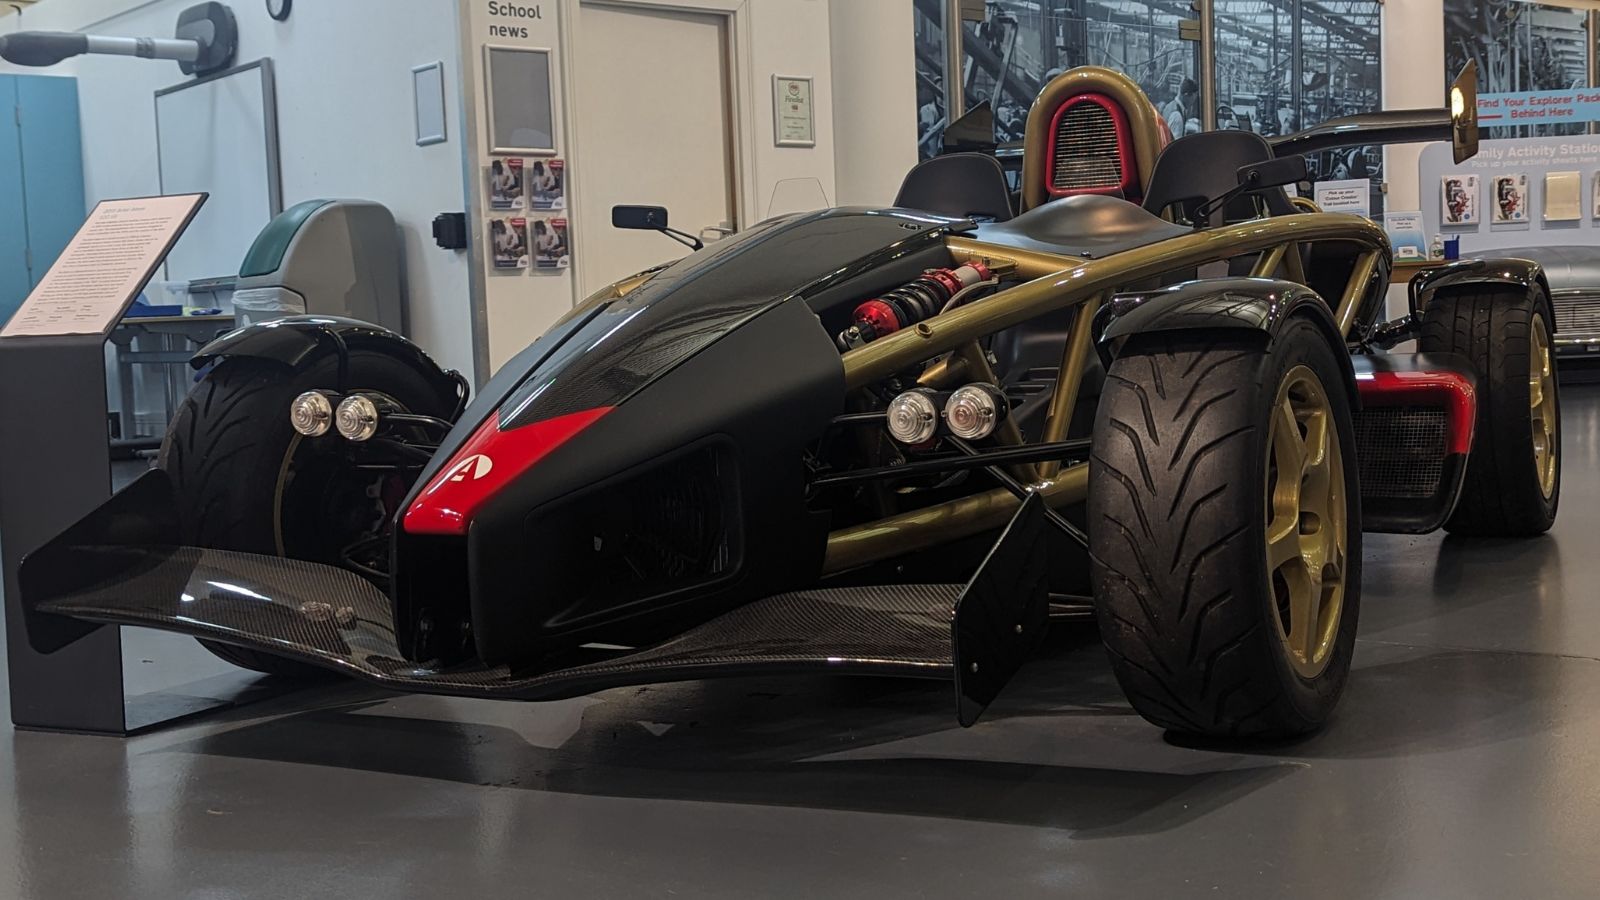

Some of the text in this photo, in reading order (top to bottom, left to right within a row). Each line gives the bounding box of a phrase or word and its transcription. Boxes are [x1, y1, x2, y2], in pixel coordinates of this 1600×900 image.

[488, 0, 542, 20] School
[489, 24, 528, 38] news
[1477, 98, 1499, 108] Find
[1503, 97, 1524, 107] Your
[1529, 95, 1573, 106] Explorer
[1511, 107, 1573, 118] Behind Here
[1508, 144, 1556, 157] Activity
[1560, 142, 1600, 155] Statio
